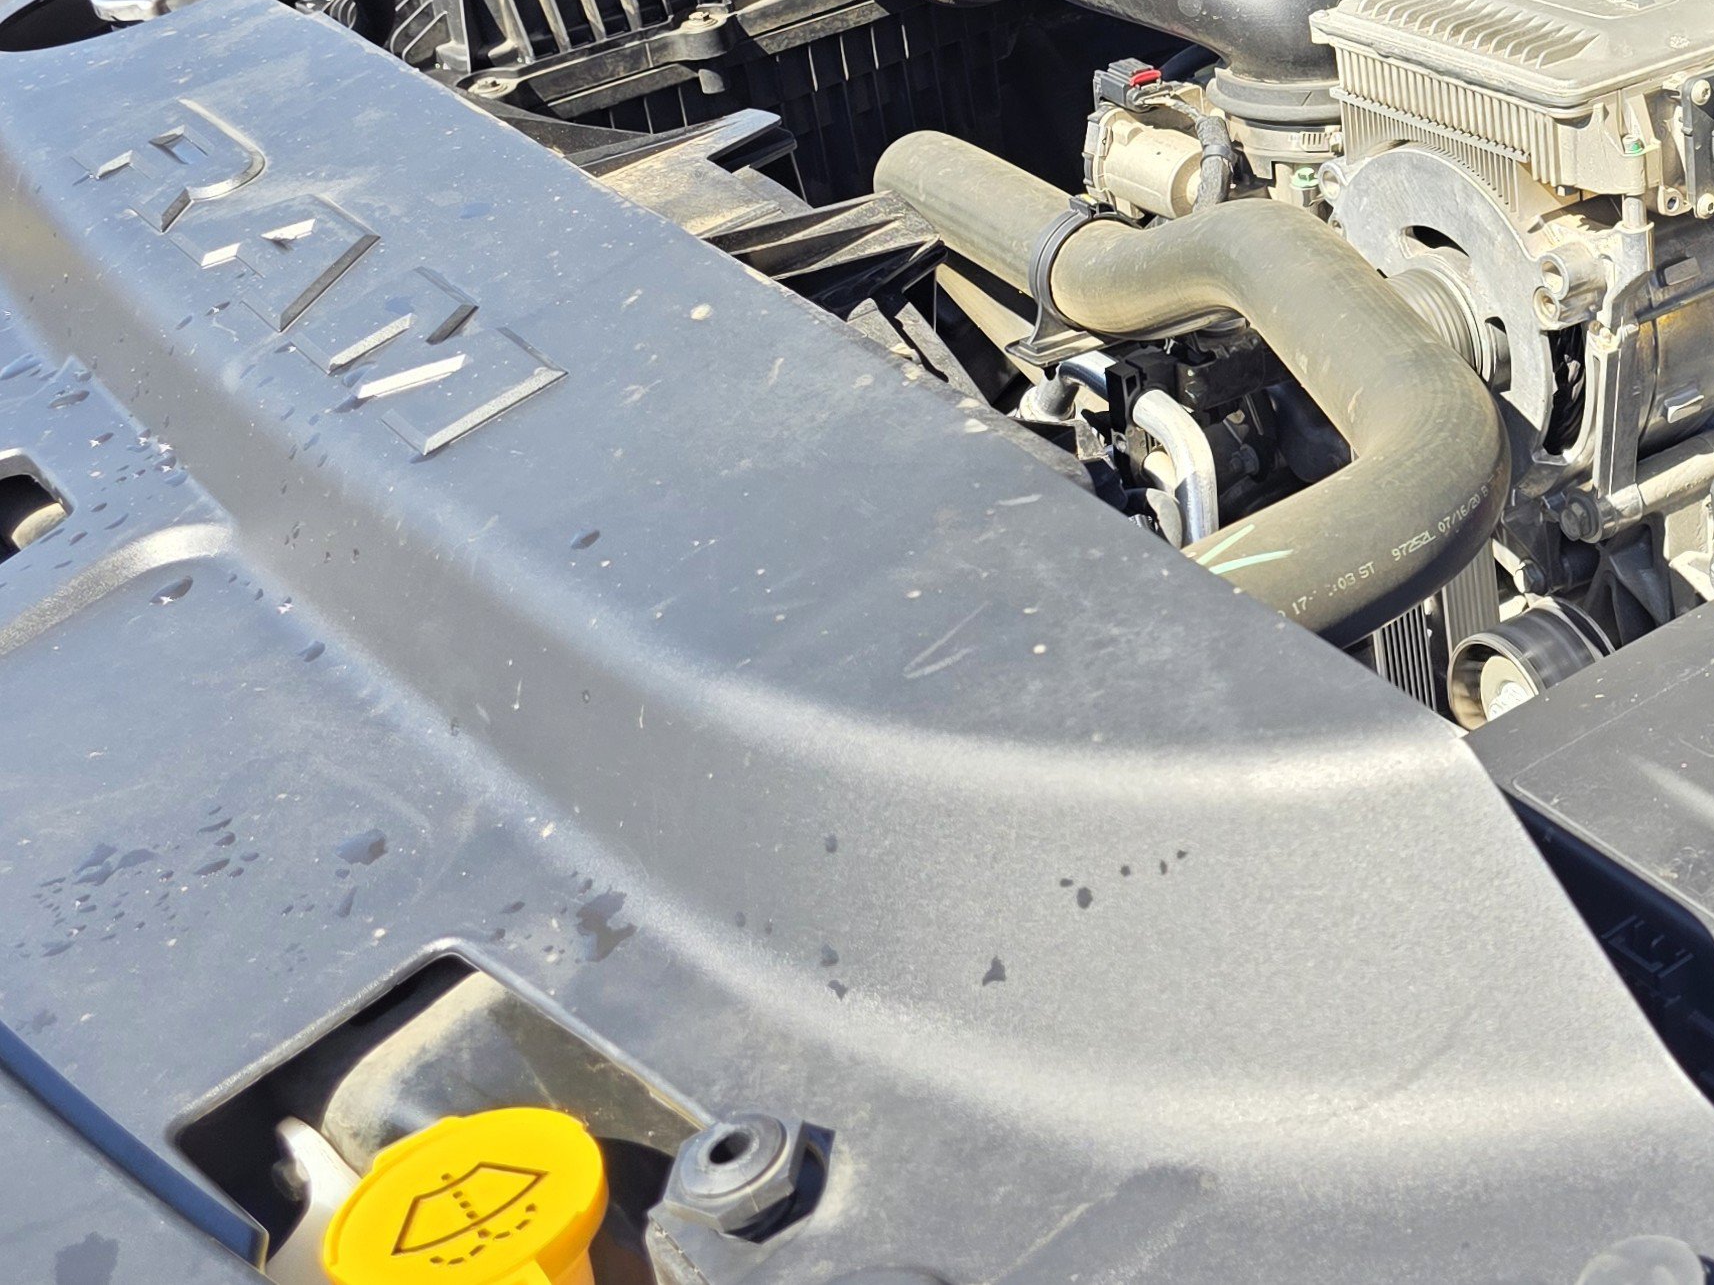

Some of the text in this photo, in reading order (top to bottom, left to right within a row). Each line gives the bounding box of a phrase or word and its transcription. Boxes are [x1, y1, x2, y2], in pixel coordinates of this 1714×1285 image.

[70, 97, 569, 456] RAM
[1359, 561, 1376, 580] ST
[1437, 493, 1481, 533] 07/16/20
